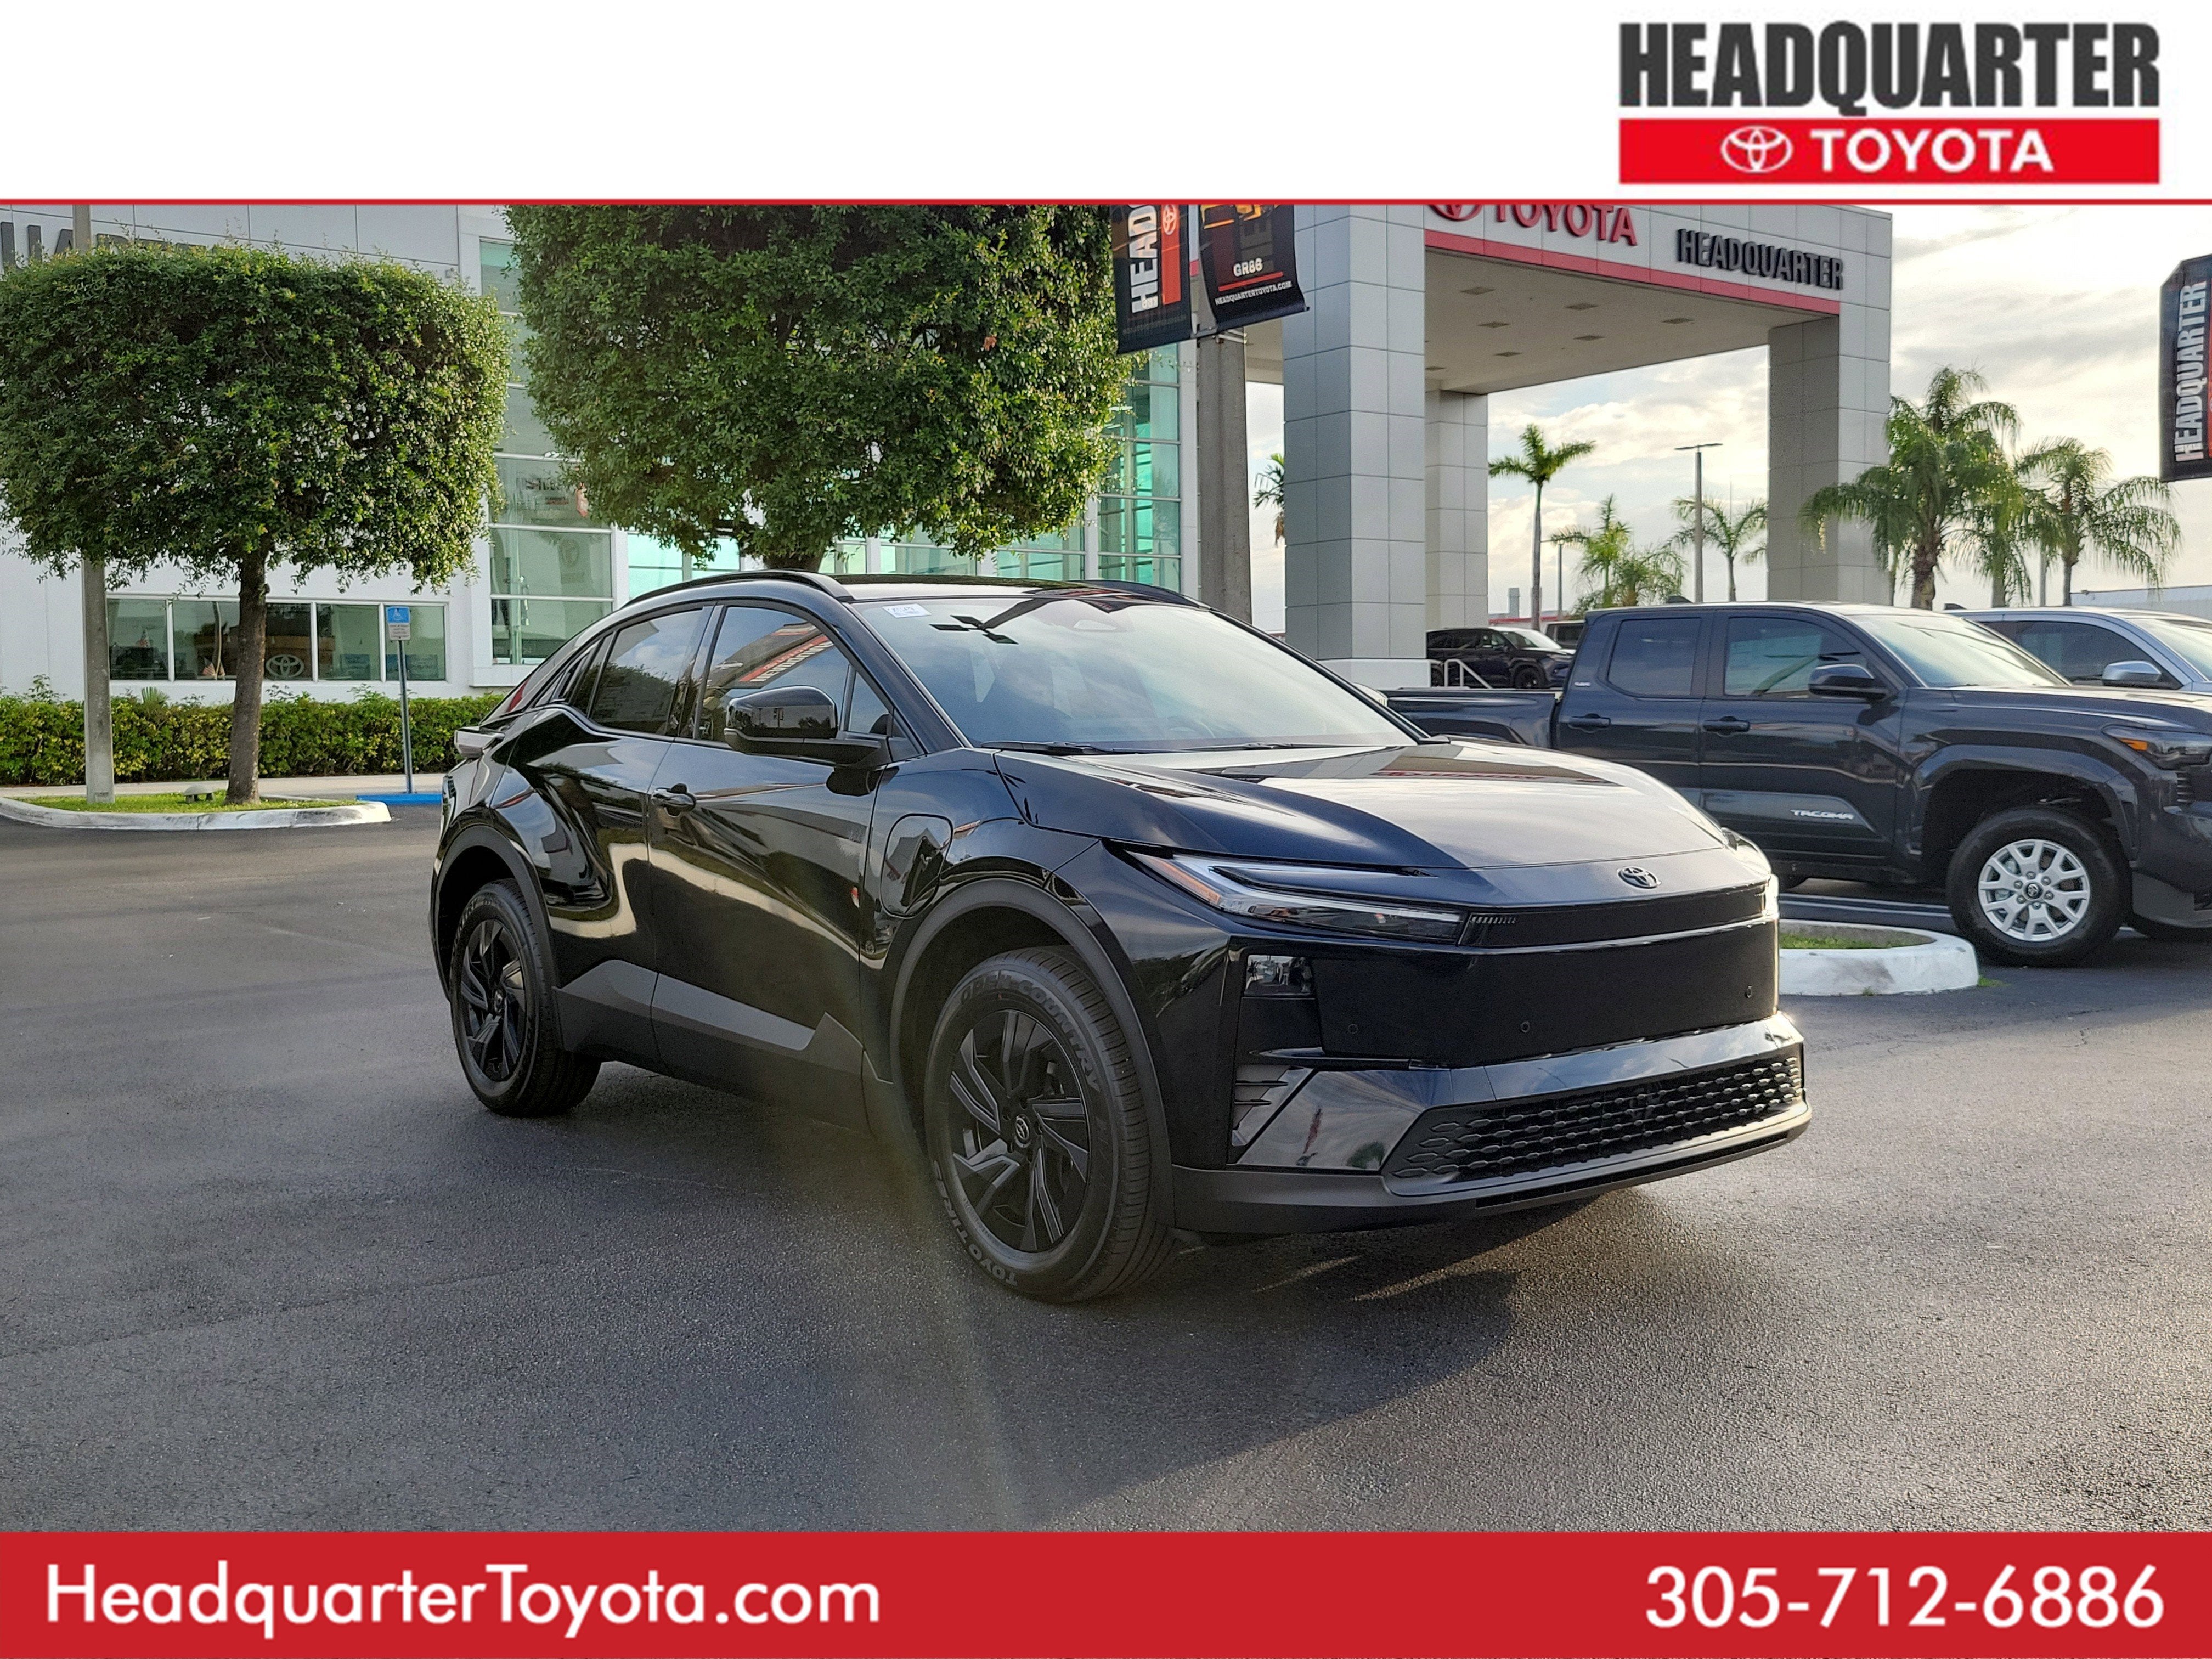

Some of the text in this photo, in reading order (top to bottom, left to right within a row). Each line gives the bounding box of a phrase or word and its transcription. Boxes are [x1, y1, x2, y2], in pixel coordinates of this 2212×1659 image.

[1128, 204, 1159, 314] HEAD
[1675, 228, 1843, 290] HEADQUARTER
[2174, 280, 2208, 462] HEADQUARTER
[1790, 809, 1854, 820] TACOMA
